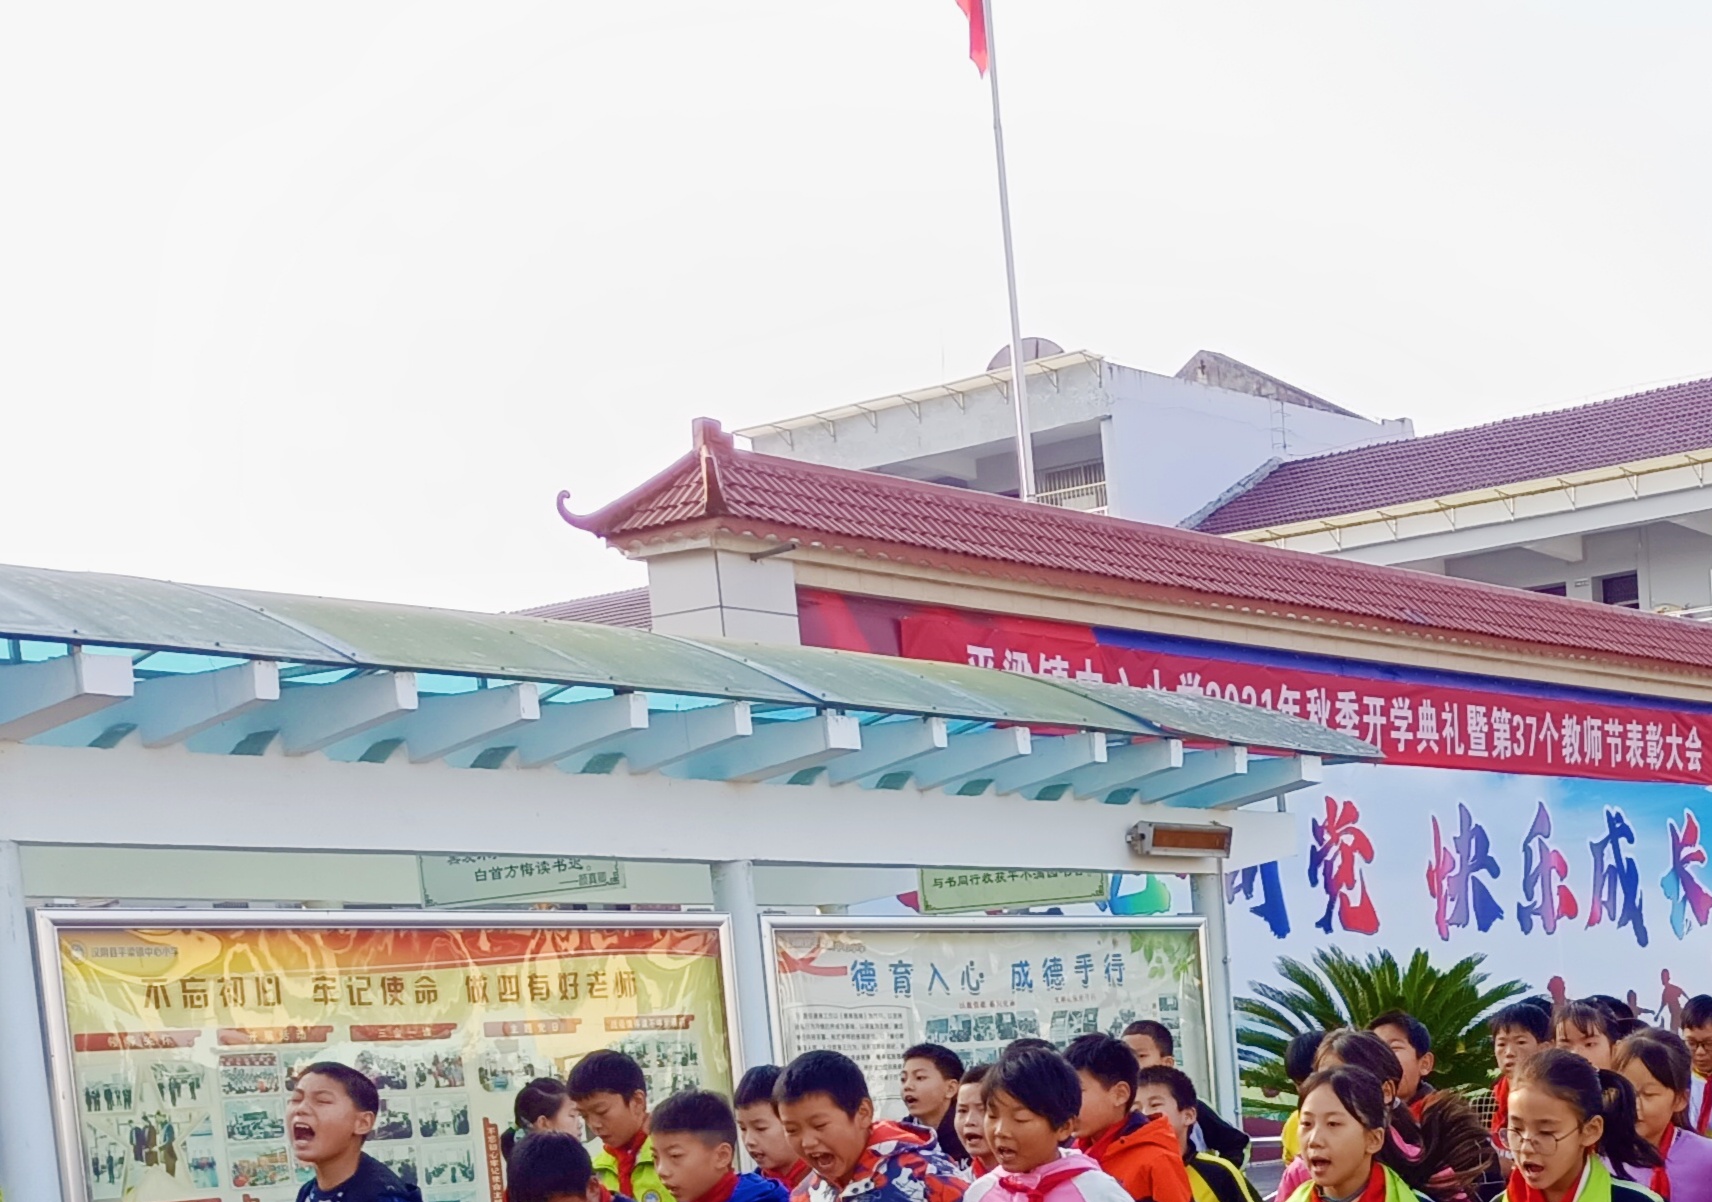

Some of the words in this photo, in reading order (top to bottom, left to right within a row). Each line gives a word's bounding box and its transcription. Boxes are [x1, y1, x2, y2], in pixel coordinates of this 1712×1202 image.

[141, 976, 282, 1009] 不忘初心
[312, 975, 439, 1006] 牢记使命
[465, 970, 638, 1004] 做四有好老师
[850, 959, 984, 996] 德育入心
